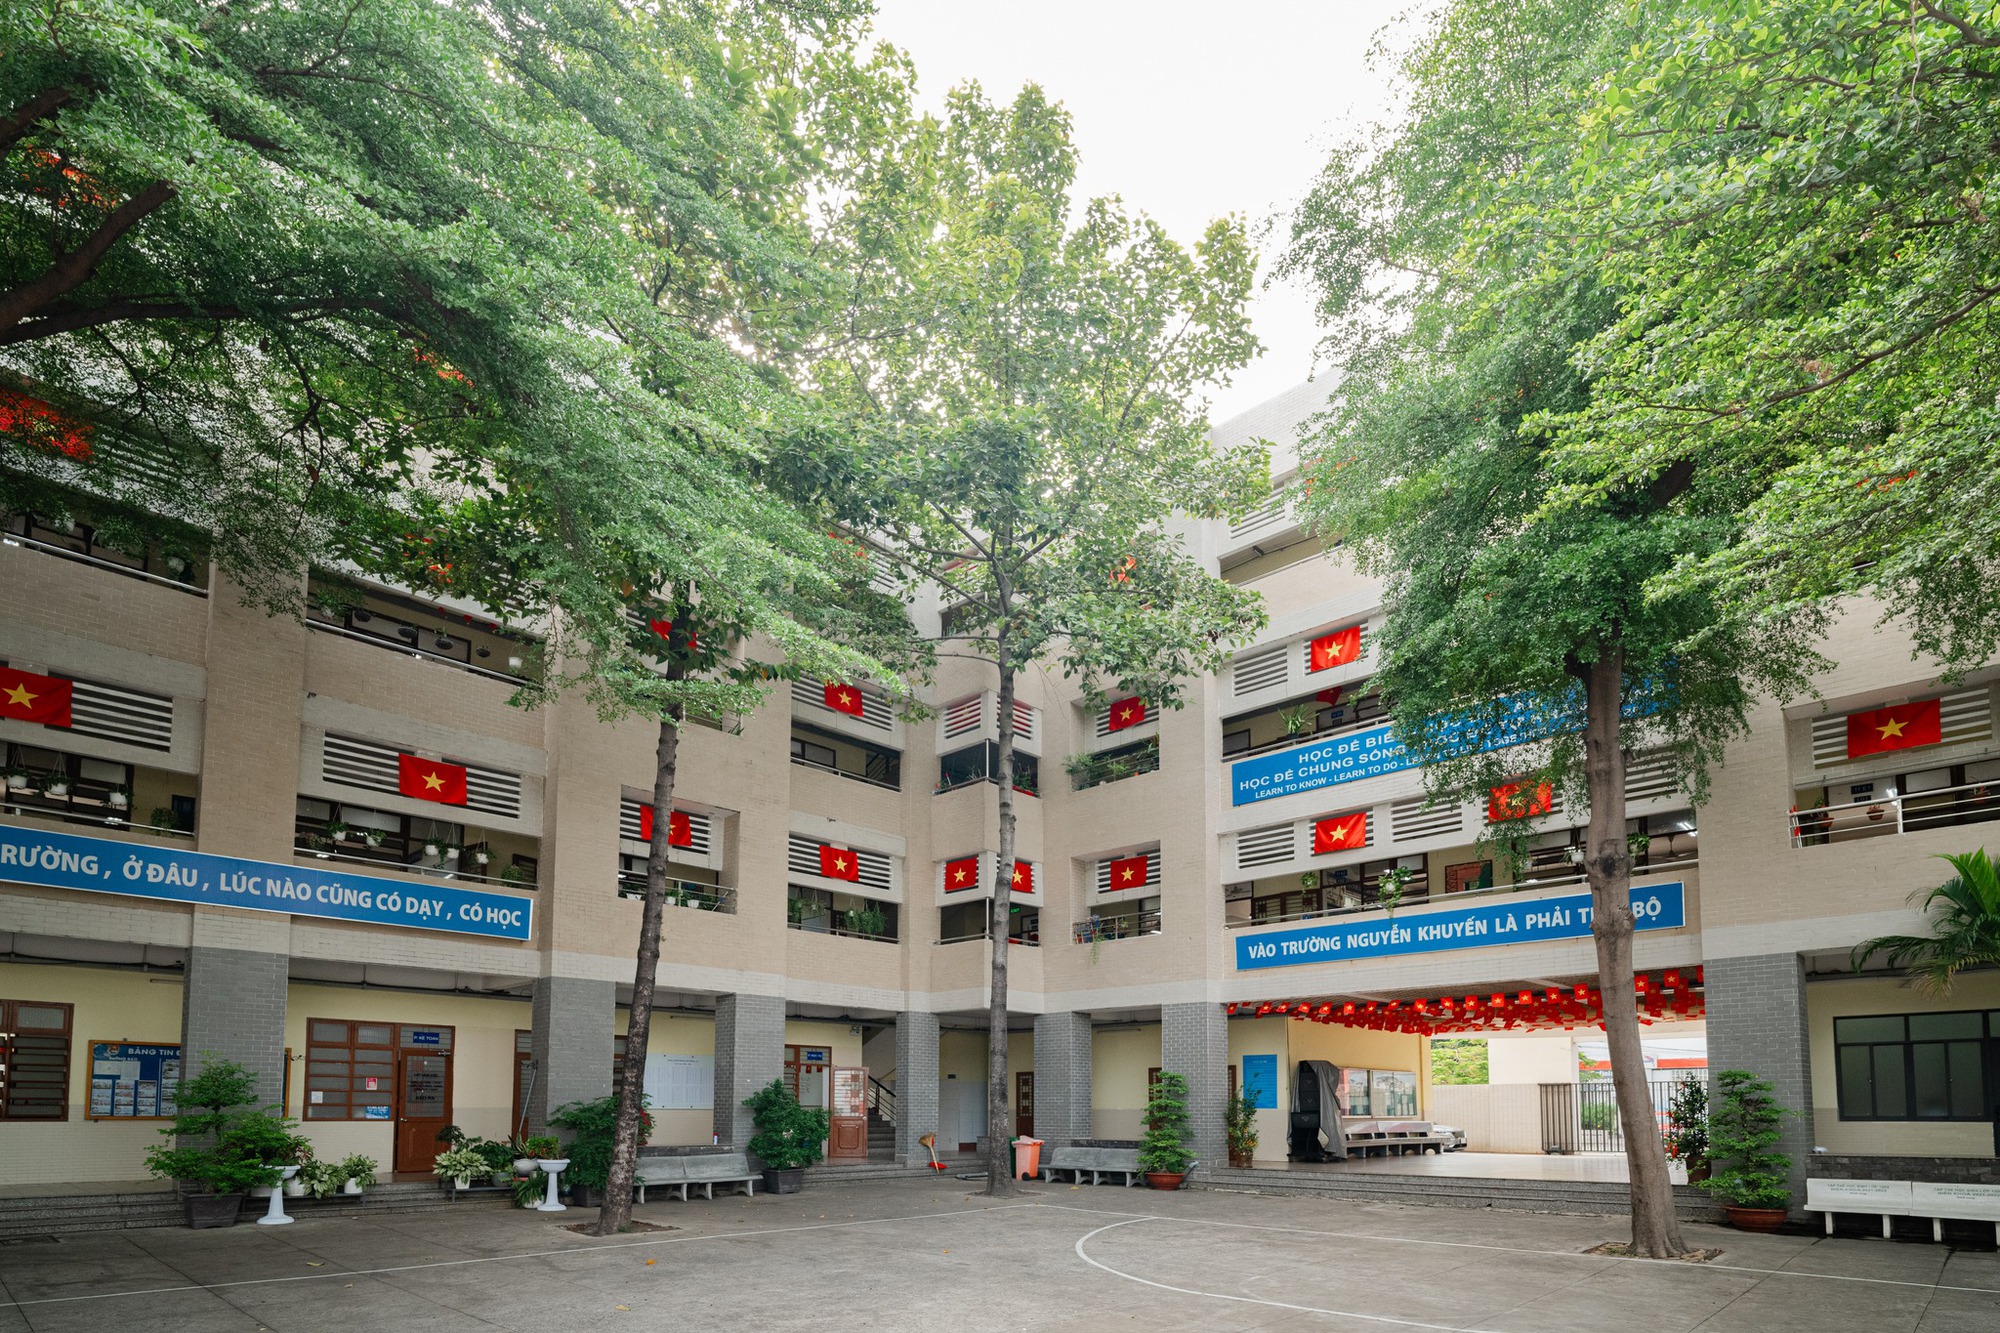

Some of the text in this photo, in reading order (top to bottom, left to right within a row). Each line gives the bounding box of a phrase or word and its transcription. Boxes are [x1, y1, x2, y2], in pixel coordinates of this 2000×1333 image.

[1298, 747, 1333, 764] HỌC
[1240, 776, 1270, 791] HỌC
[1298, 757, 1354, 777] CHUNG
[1255, 786, 1284, 799] LEARN
[1285, 783, 1298, 793] TO
[1299, 776, 1327, 790] KNOW
[1334, 768, 1366, 783] LEARN
[1368, 765, 1381, 774] TO
[1383, 761, 1398, 771] DO
[123, 854, 143, 880] Ở
[219, 871, 261, 895] LÚC
[266, 877, 312, 901] NÀO
[316, 883, 372, 908] CŨNG
[376, 892, 401, 912] CÓ
[459, 902, 481, 922] CÓ
[486, 907, 522, 930] HỌC
[1248, 942, 1276, 959] VÀO
[1281, 936, 1341, 956] TRƯỜNG
[1347, 924, 1411, 949] NGUYỄN
[1418, 915, 1487, 941] KHUYẾN
[1495, 913, 1518, 933] LÀ
[1525, 906, 1570, 930] PHẢI
[1632, 896, 1662, 921] BỘ
[128, 1047, 157, 1055] BẢNG
